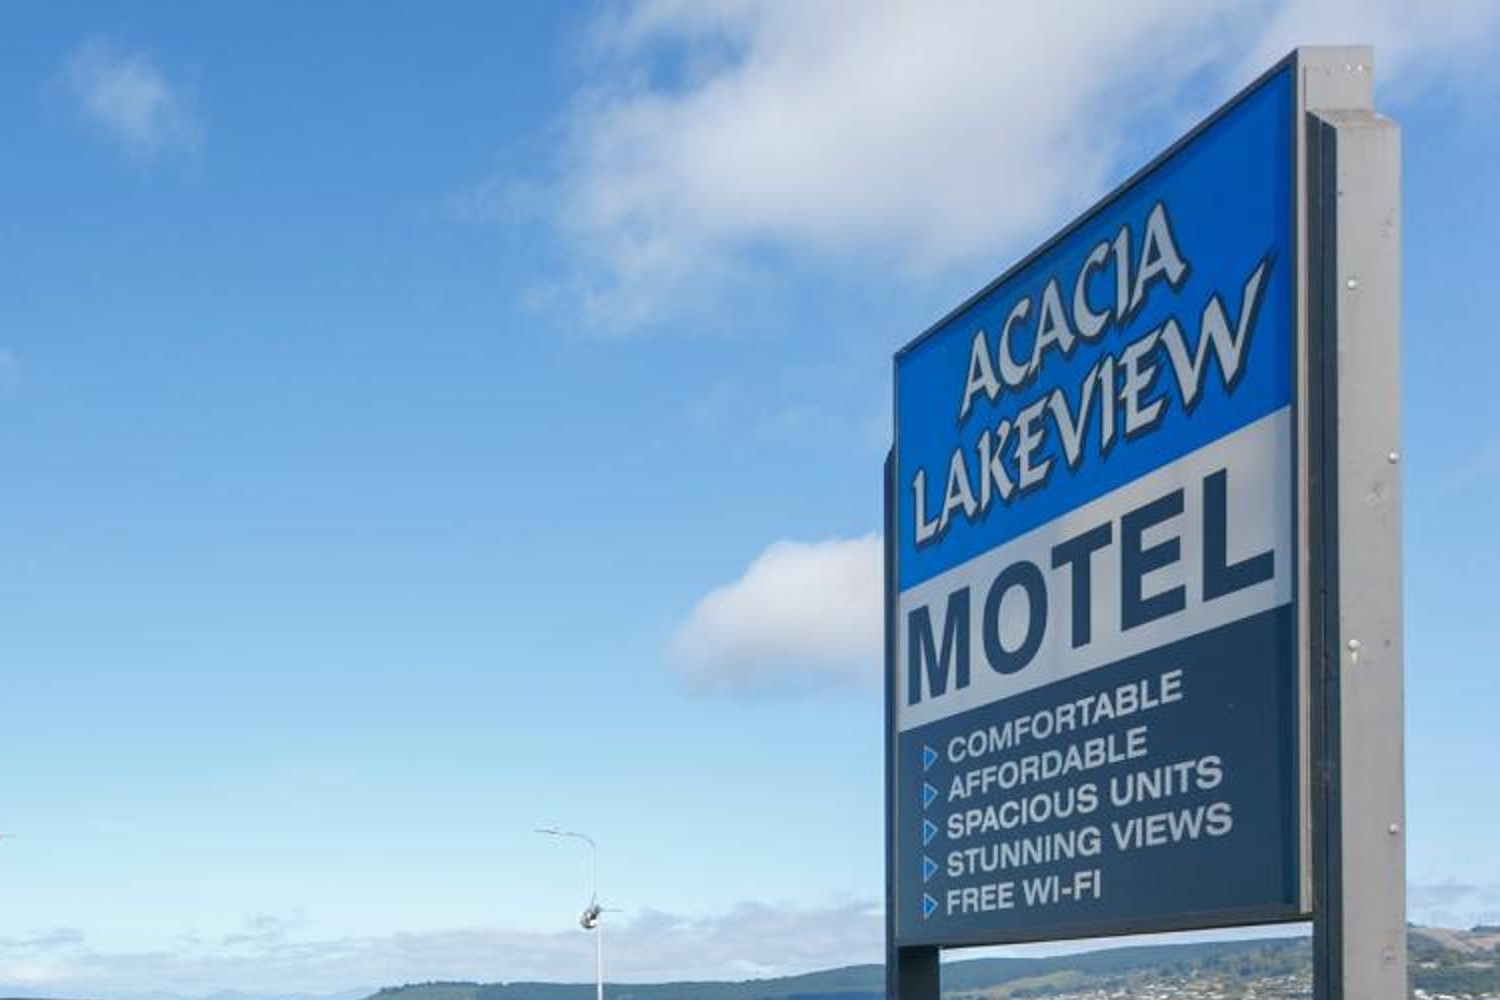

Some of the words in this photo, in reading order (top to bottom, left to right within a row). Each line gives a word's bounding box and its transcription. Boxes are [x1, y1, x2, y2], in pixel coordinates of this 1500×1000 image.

[959, 200, 1189, 421] ACACIA
[912, 255, 1271, 546] LAKEVIEW
[908, 468, 1275, 707] MOTEL
[947, 669, 1184, 763] COMFORTABLE
[947, 783, 1099, 840] SPACIOUS
[1110, 755, 1223, 807] UNITS
[948, 726, 1149, 802] AFFORDABLE
[947, 826, 1101, 878] STUNNING
[1111, 802, 1234, 850] VIEWS
[947, 881, 1015, 915] FREE
[1022, 869, 1101, 906] WI-FI
